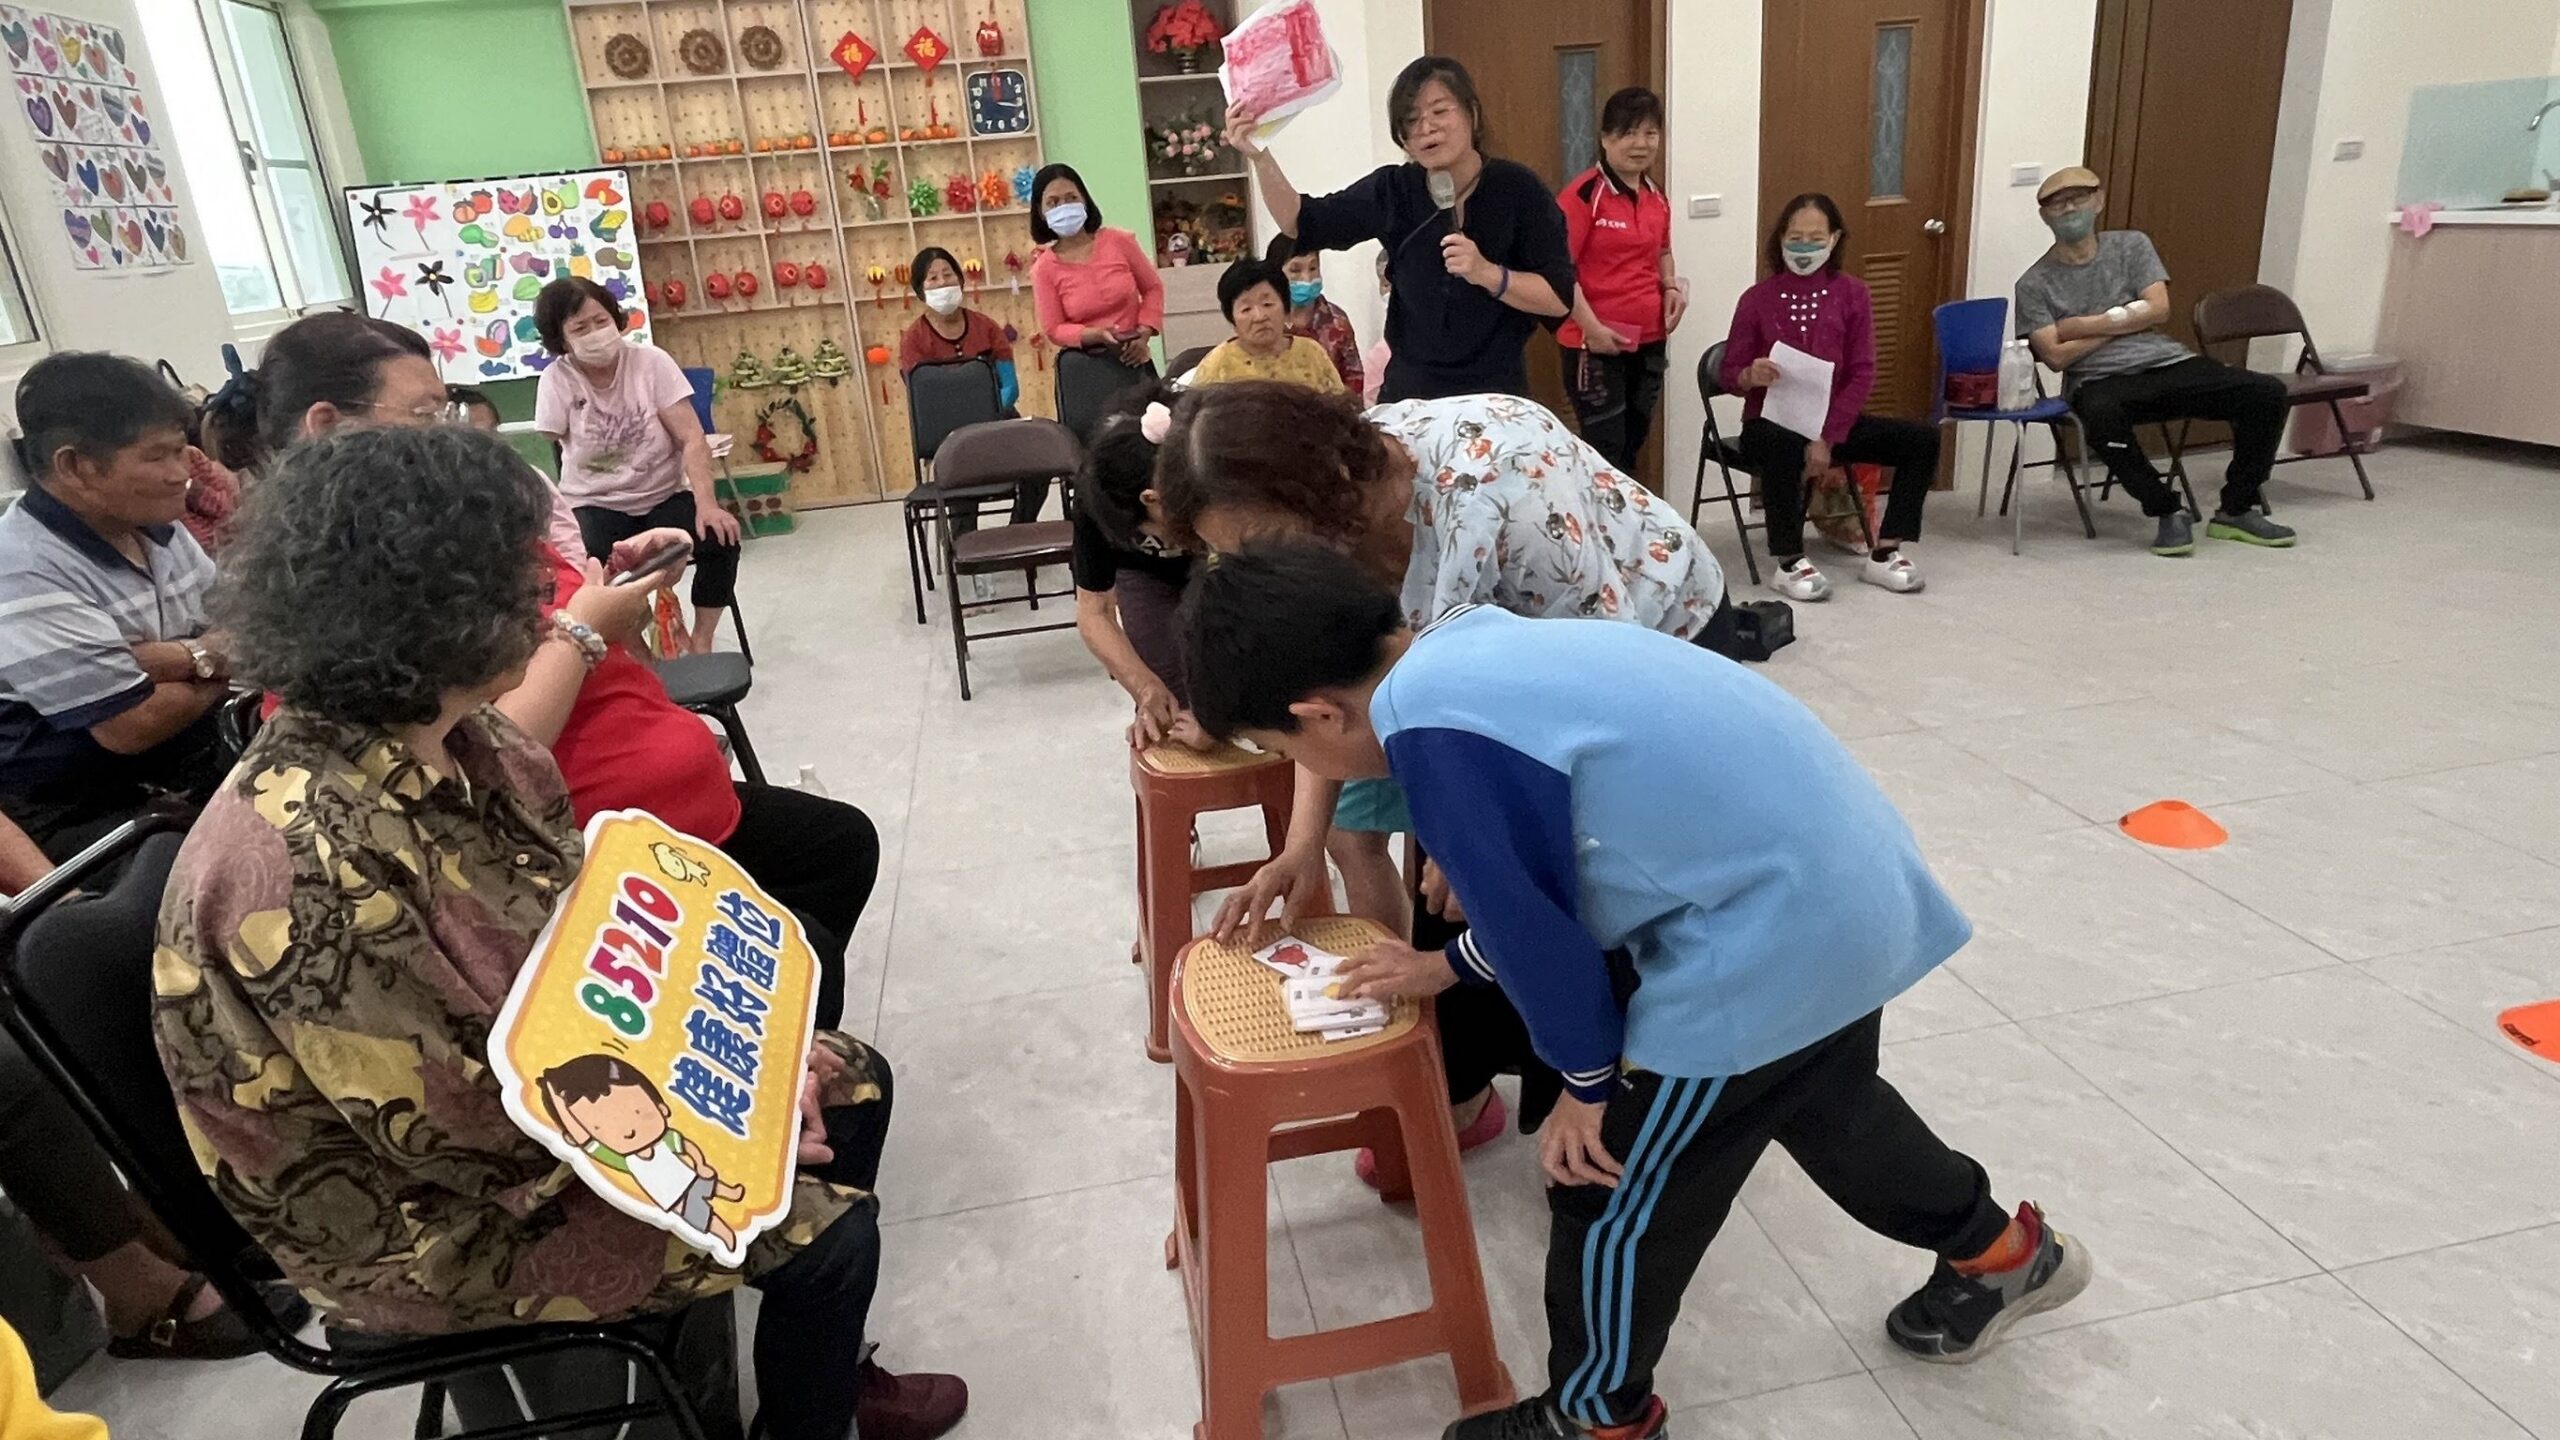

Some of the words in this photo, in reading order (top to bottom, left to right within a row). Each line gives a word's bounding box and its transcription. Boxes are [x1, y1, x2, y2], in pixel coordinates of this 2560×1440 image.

[913, 37, 937, 58] 福
[841, 43, 863, 65] 福
[970, 87, 983, 97] 10
[1014, 84, 1022, 94] 2
[985, 120, 993, 129] 7
[998, 119, 1005, 129] 6
[1010, 117, 1018, 127] 5
[581, 876, 679, 1036] 85210
[668, 891, 780, 1137] 健康好體位
